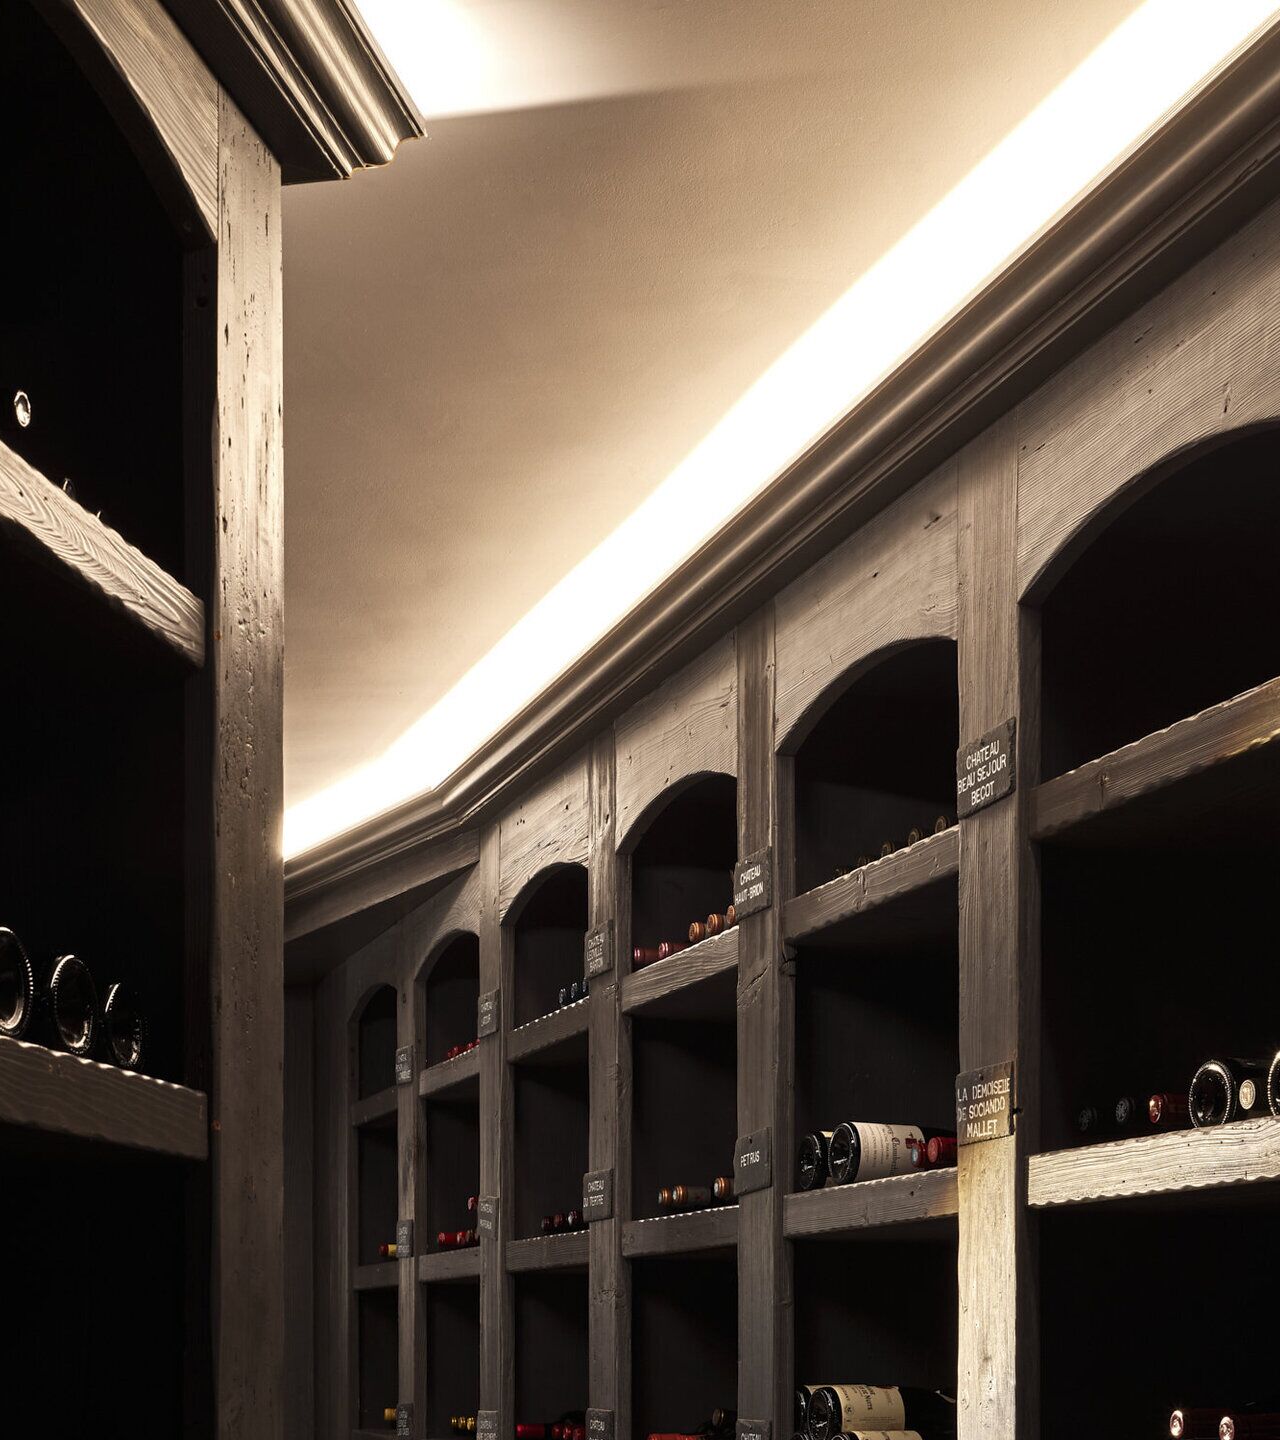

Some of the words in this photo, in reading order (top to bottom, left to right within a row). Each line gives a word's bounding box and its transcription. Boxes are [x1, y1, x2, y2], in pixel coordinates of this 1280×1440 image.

[966, 739, 1000, 770] CHATEAU
[957, 773, 976, 794] BEAU
[977, 754, 1007, 782] SEJOUR
[971, 781, 995, 805] BECOT
[740, 864, 761, 886] CHATEAU
[734, 881, 764, 906] HAUT-BRION
[957, 1087, 968, 1102] LA
[972, 1078, 1011, 1100] DEMOISELLE
[957, 1107, 967, 1122] DE
[968, 1096, 1006, 1119] SOCIANDO
[966, 1119, 998, 1138] MALLET
[740, 1150, 760, 1168] PETRUS
